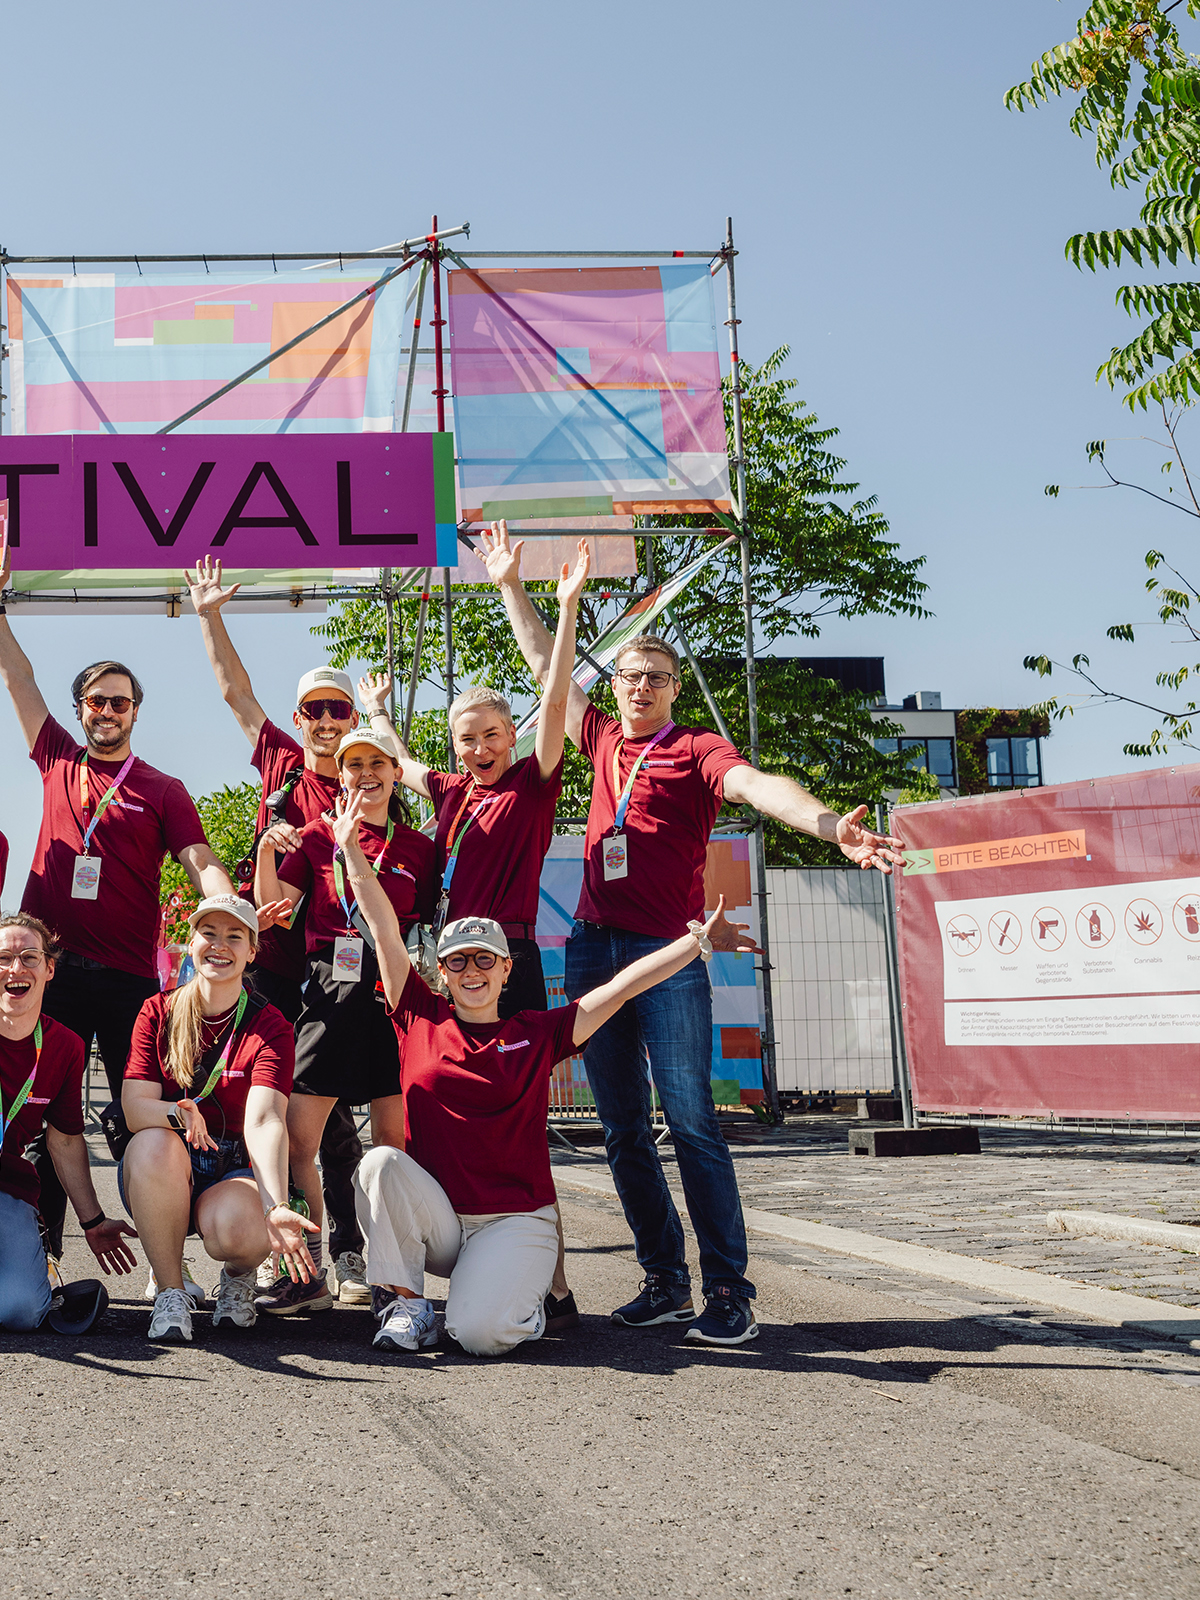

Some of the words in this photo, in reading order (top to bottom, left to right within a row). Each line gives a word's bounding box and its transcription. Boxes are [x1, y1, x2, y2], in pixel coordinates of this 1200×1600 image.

[939, 850, 982, 867] BITTE
[989, 838, 1080, 861] BEACHTEN
[208, 1063, 225, 1089] FESTIVAL
[9, 1110, 15, 1118] KI
[12, 1082, 32, 1110] FESTIVAL
